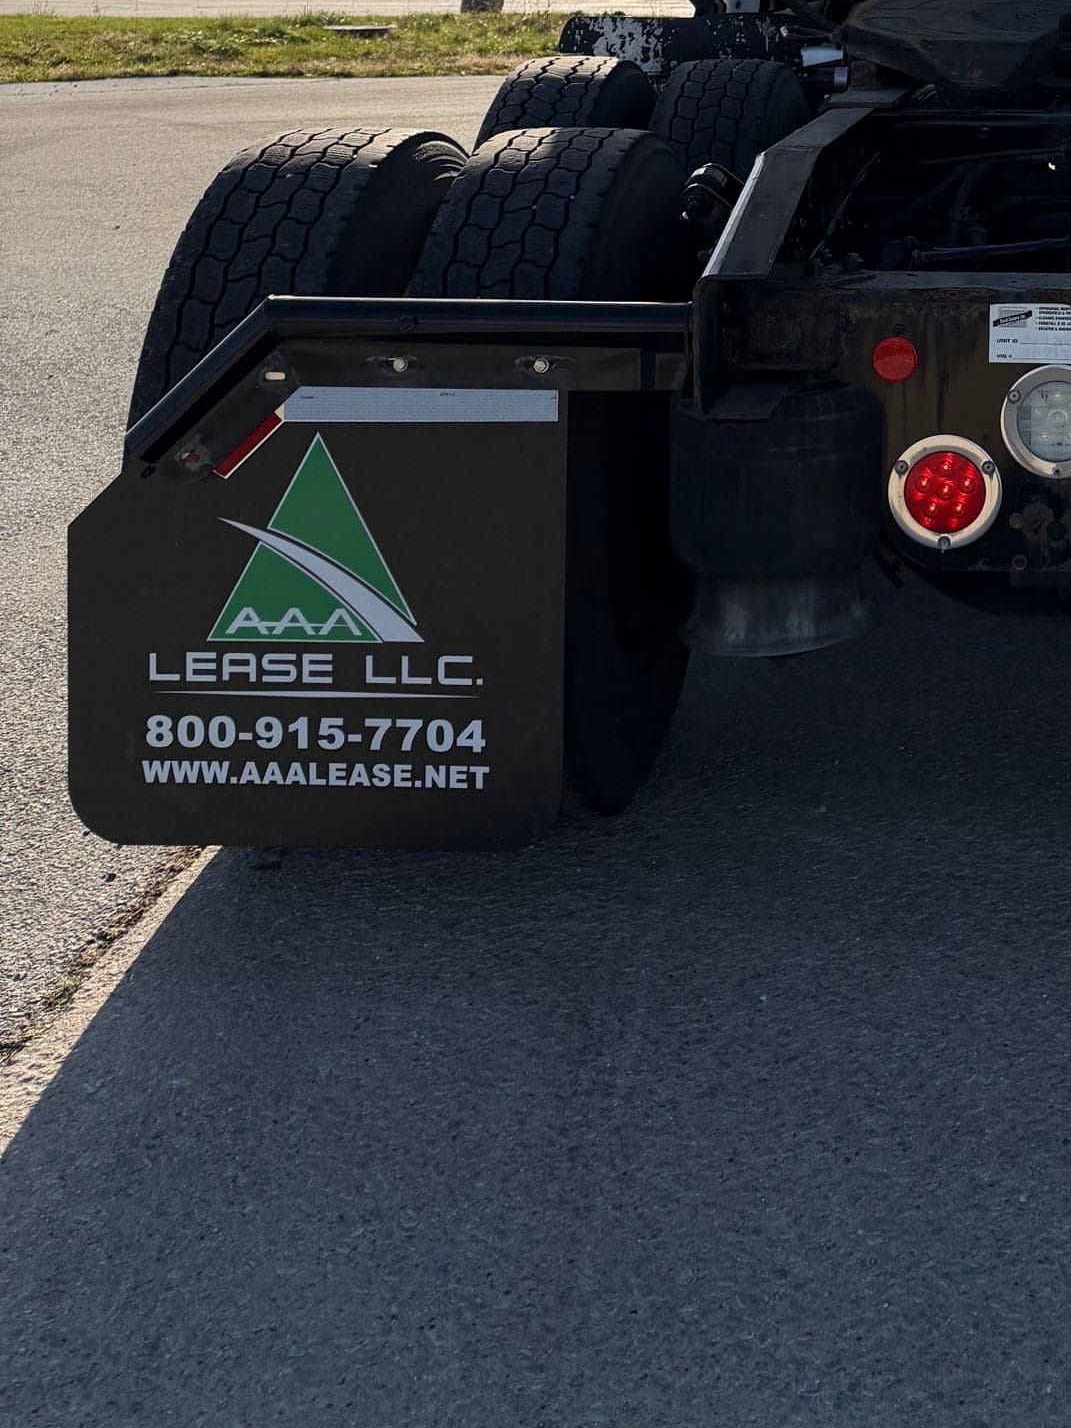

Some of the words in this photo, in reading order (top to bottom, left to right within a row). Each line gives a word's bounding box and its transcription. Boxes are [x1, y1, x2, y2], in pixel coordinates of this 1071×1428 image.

[225, 606, 363, 636] AAA
[148, 651, 334, 685] LEASE
[365, 655, 484, 686] LLC.
[145, 714, 487, 754] 800-915-7704
[142, 759, 490, 790] WWW.AAALEASE.NET
